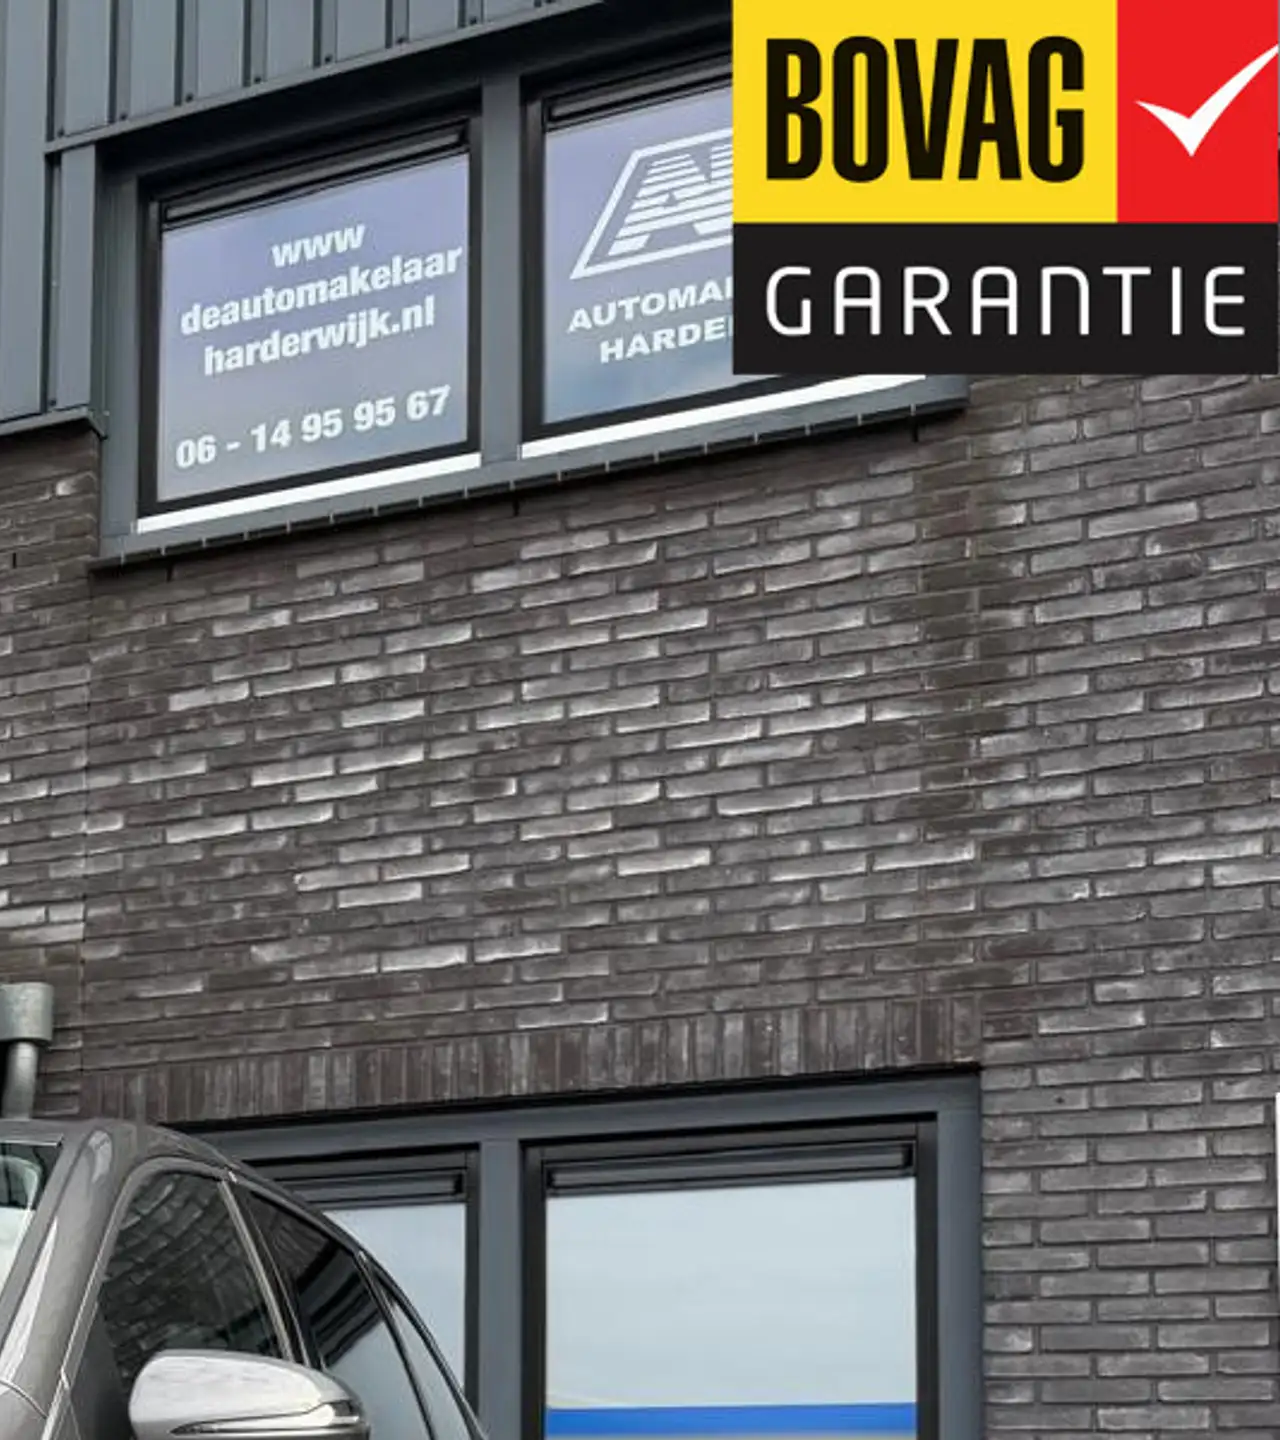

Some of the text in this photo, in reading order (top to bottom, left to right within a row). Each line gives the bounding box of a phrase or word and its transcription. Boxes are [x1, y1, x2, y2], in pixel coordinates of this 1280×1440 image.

[271, 224, 366, 268] www
[180, 247, 462, 335] deautomakelaar
[204, 295, 436, 376] harderwijk.nl
[176, 434, 216, 469] 06
[251, 419, 292, 452] 14
[301, 408, 343, 442] 95
[353, 396, 396, 431] 95
[406, 384, 451, 421] 67
